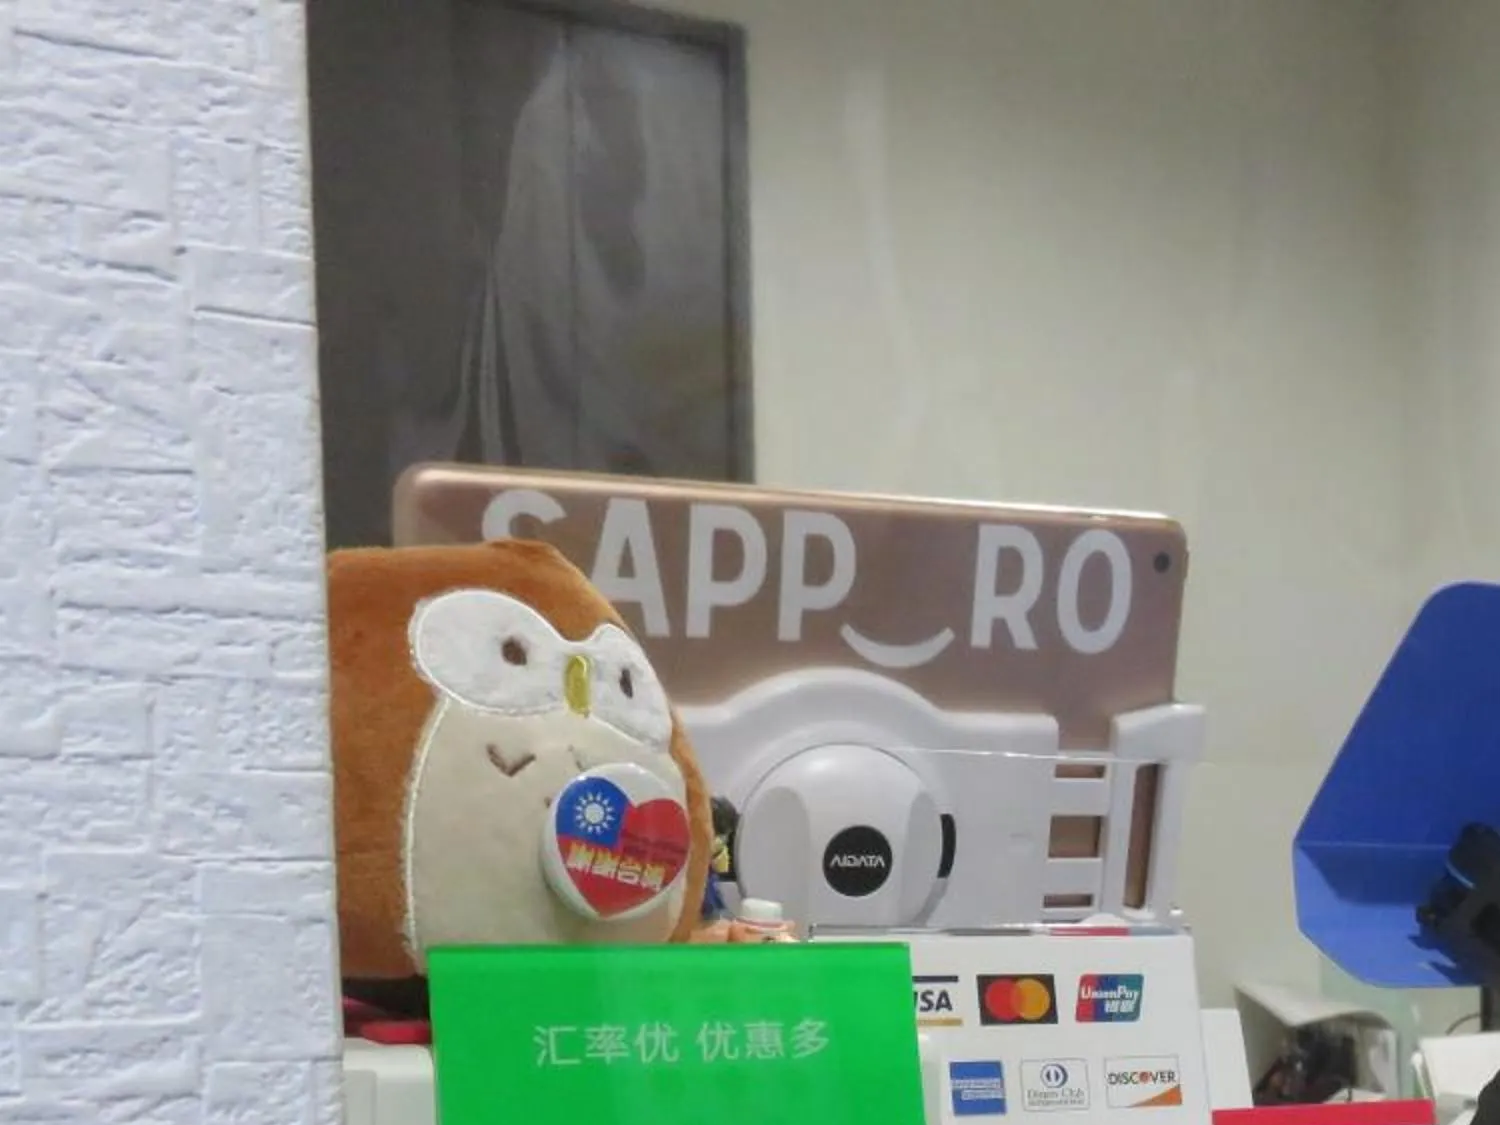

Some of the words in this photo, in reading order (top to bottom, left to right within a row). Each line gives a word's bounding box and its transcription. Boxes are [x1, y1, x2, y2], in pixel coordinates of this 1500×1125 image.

[913, 989, 953, 1012] ISA
[533, 1021, 680, 1068] 汇率优
[695, 1018, 830, 1063] 优惠多
[1107, 1070, 1176, 1086] DISCOVER
